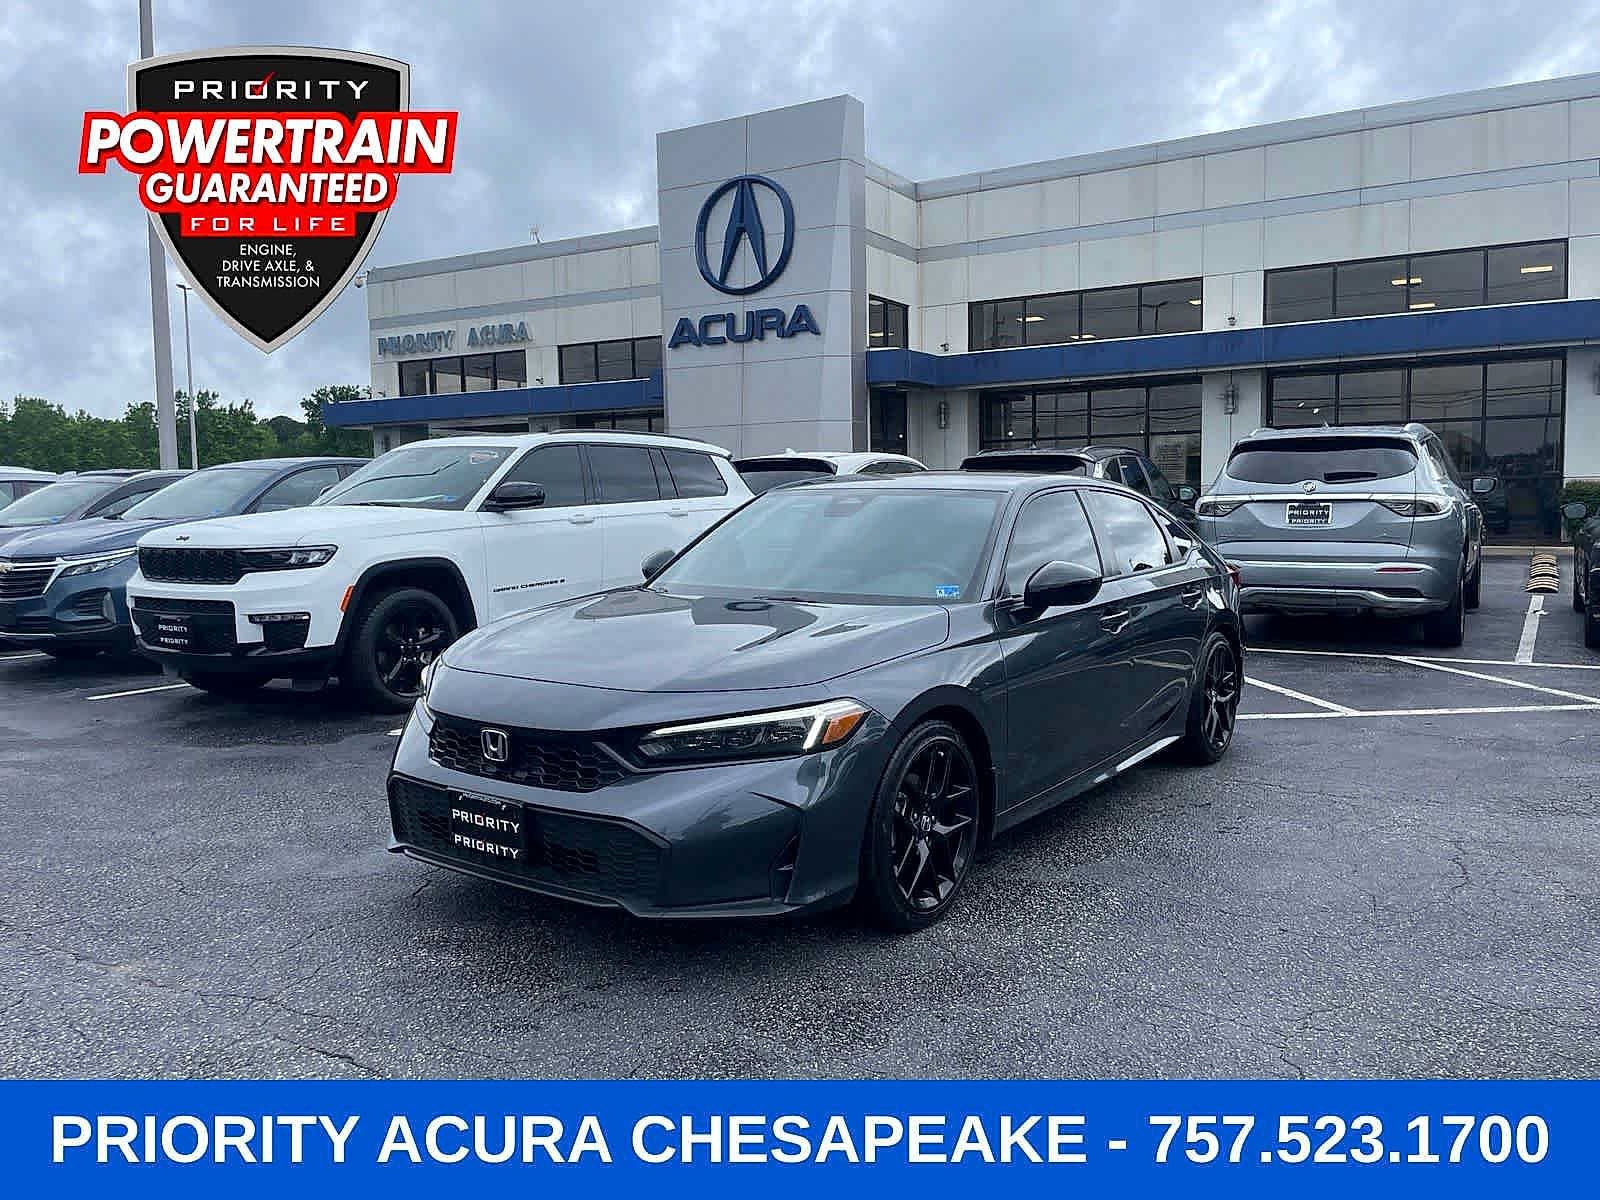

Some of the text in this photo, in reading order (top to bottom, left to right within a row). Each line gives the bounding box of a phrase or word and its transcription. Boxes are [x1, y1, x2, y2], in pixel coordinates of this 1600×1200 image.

[377, 321, 533, 355] PRIORITY ACURA
[668, 304, 821, 349] ACURA
[158, 624, 188, 633] PRIORITY
[452, 808, 520, 833] PRIORITY
[454, 834, 519, 859] PRIORITY
